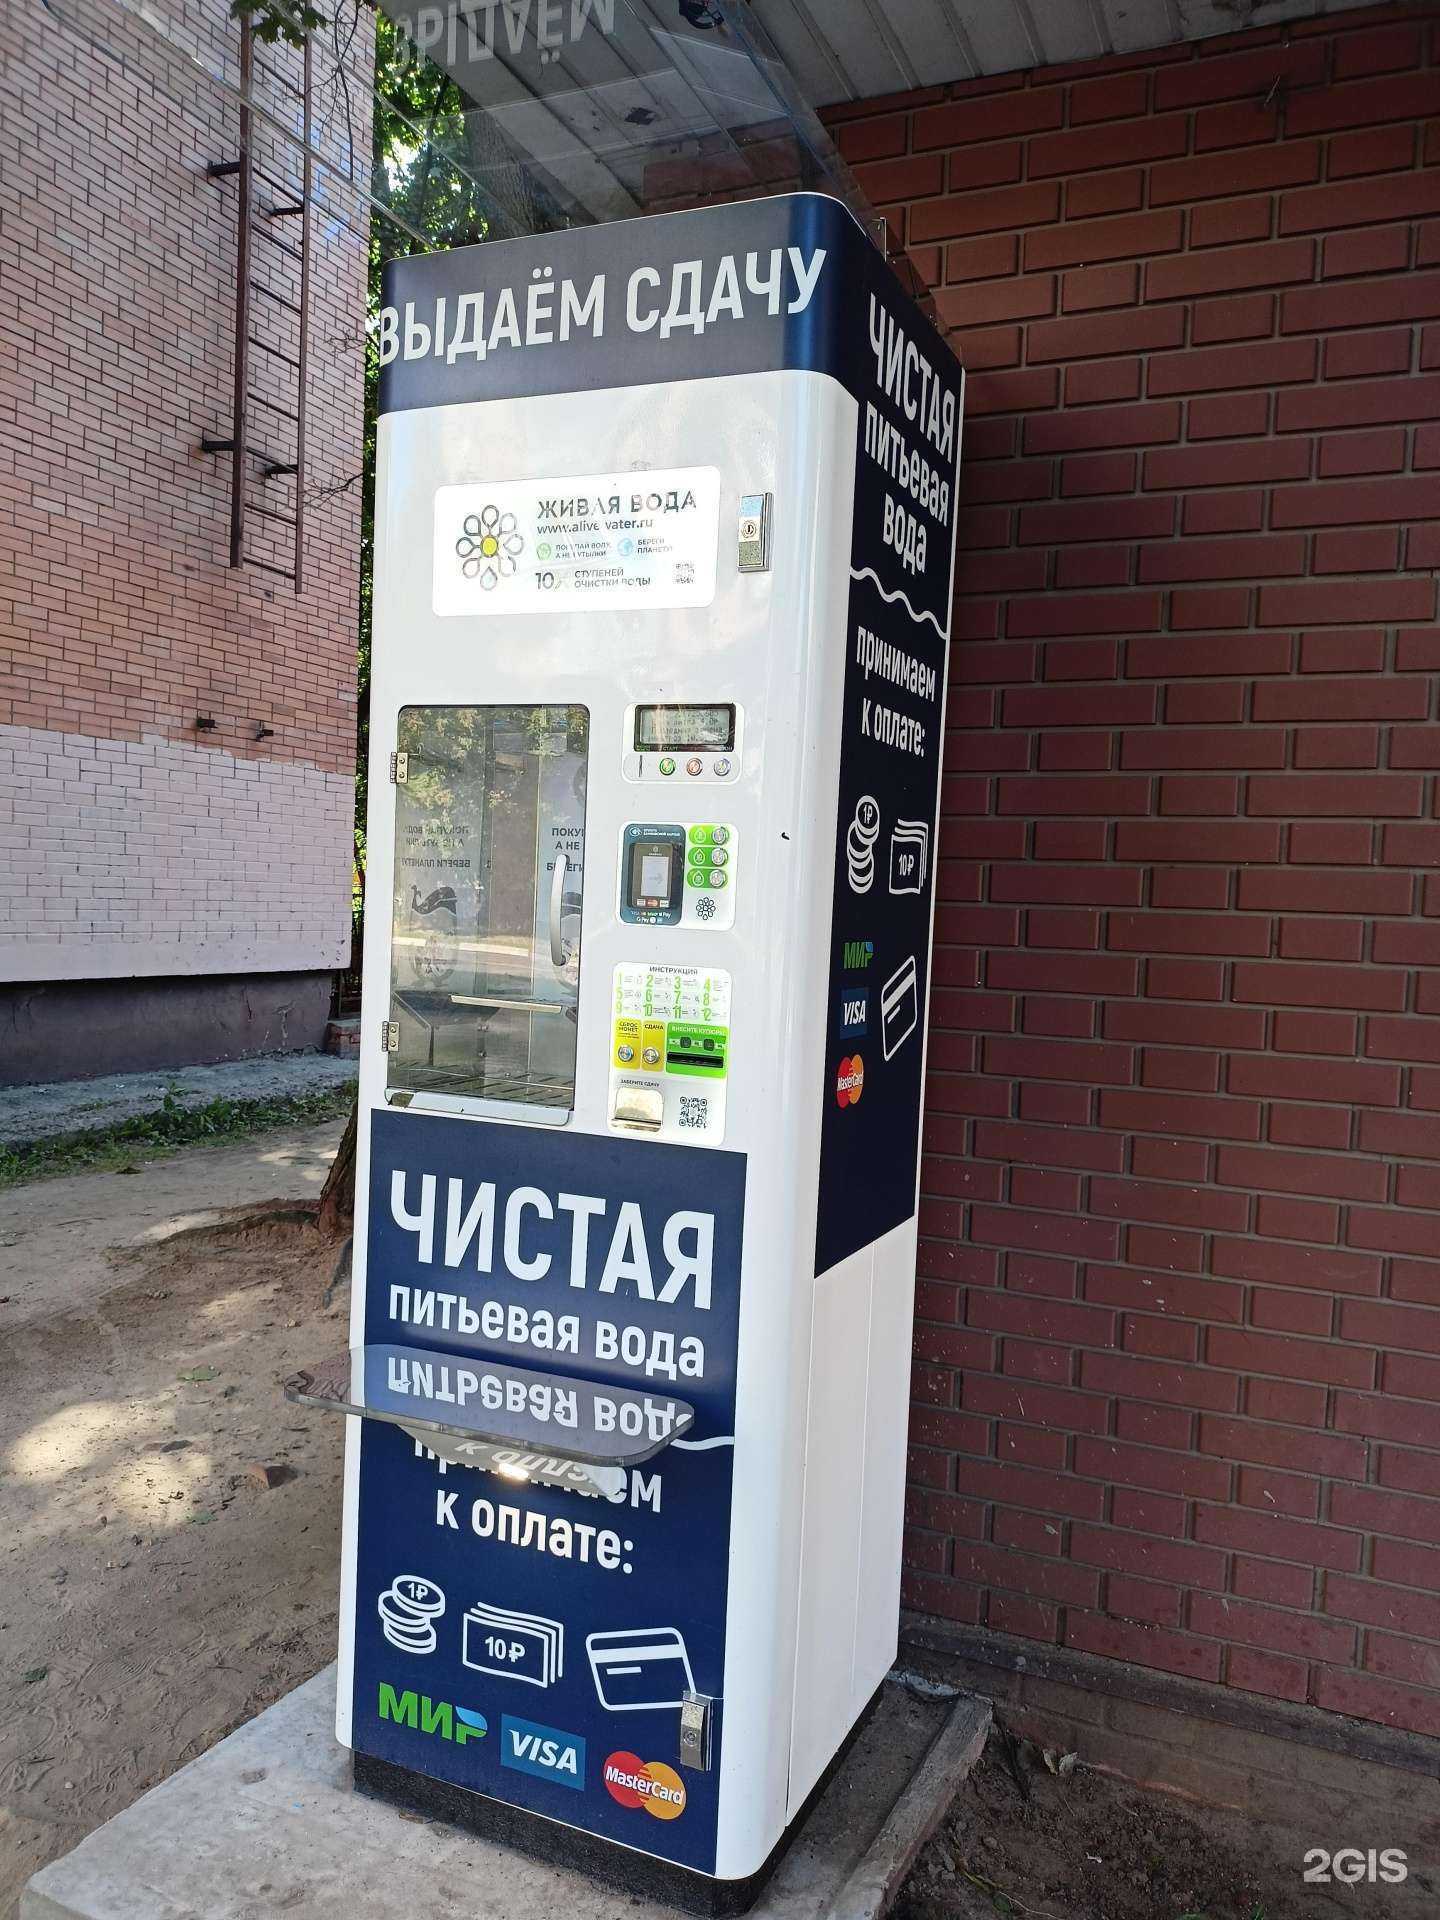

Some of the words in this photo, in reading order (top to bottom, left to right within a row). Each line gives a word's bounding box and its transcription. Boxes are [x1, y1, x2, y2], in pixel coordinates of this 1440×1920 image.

[379, 267, 606, 366] ВЫДАЁМ
[625, 246, 828, 339] СДАЧУ
[869, 291, 956, 464] ЧИСТАЯ
[865, 400, 949, 527] питьевая
[631, 490, 697, 514] ВОДА
[883, 492, 927, 576] вода
[574, 567, 624, 579] СТУПЕНЕЙ
[857, 626, 936, 702] принимаем
[874, 704, 926, 758] оплате:
[555, 841, 563, 850] А
[566, 841, 580, 850] НЕ
[843, 941, 873, 970] МИР
[674, 990, 681, 1004] 7
[843, 1000, 867, 1026] VISA
[390, 1169, 715, 1310] ЧИСТАЯ
[388, 1283, 580, 1354] питьевая
[595, 1320, 706, 1381] вода
[471, 1498, 634, 1575] оплате:
[378, 1682, 488, 1745] МИР
[508, 1729, 577, 1775] VISA
[605, 1765, 684, 1805] MasterCard
